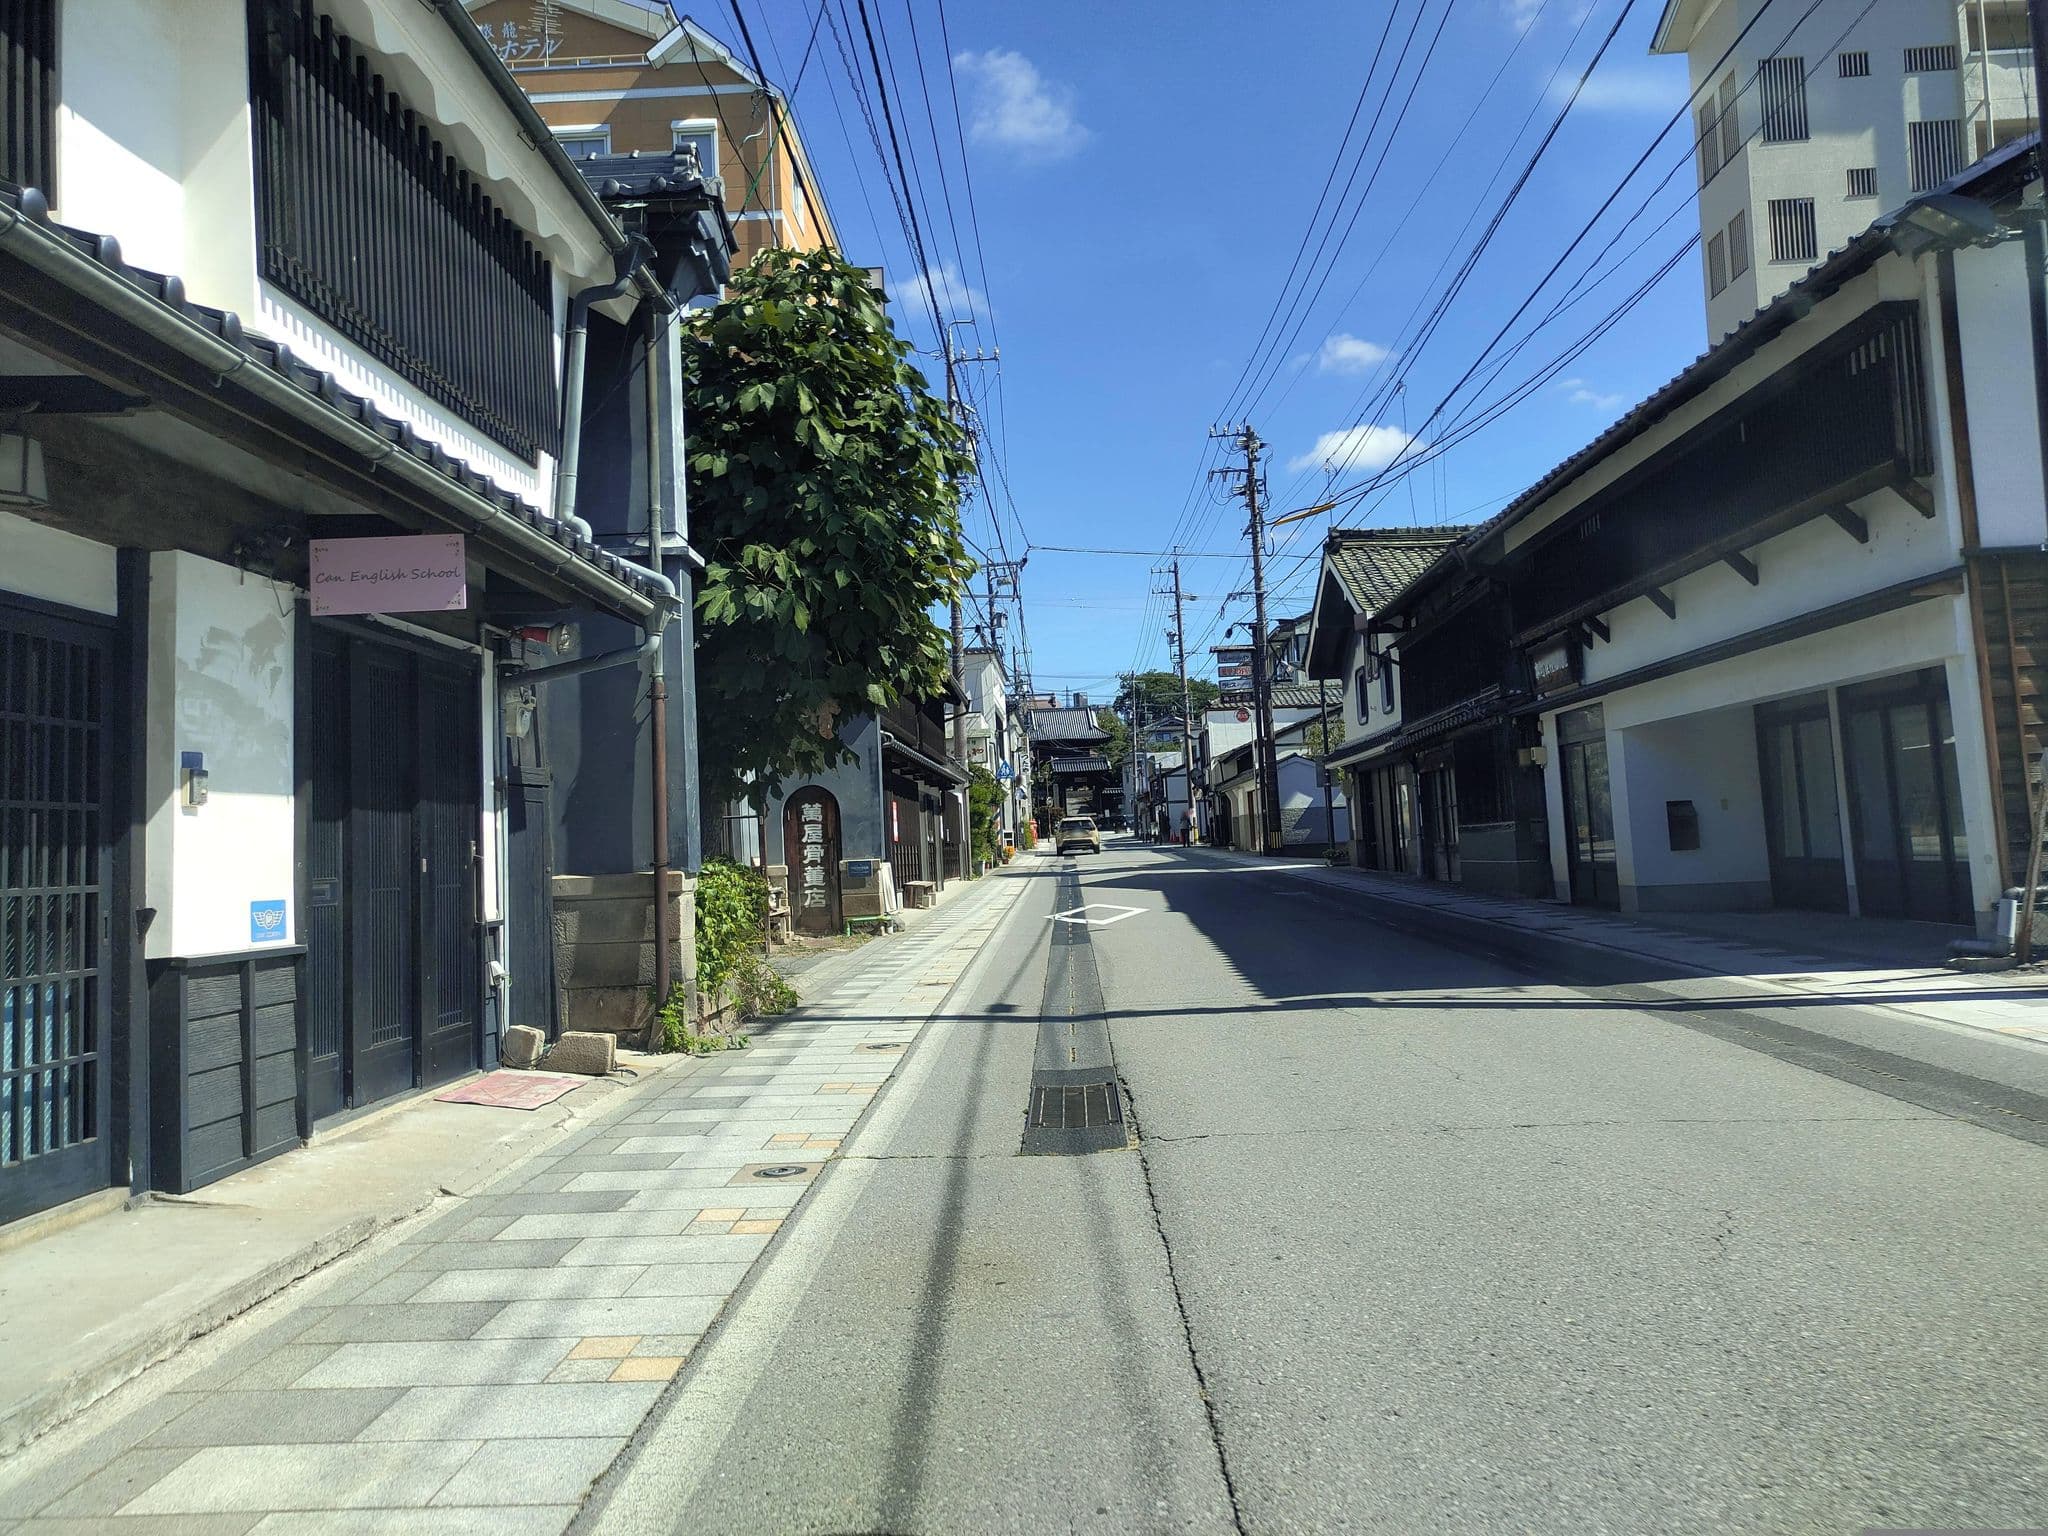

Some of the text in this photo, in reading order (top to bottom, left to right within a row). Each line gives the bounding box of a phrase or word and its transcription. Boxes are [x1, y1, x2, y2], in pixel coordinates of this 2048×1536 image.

[315, 566, 461, 584] Can English School
[801, 802, 826, 909] 萬屋骨董店
